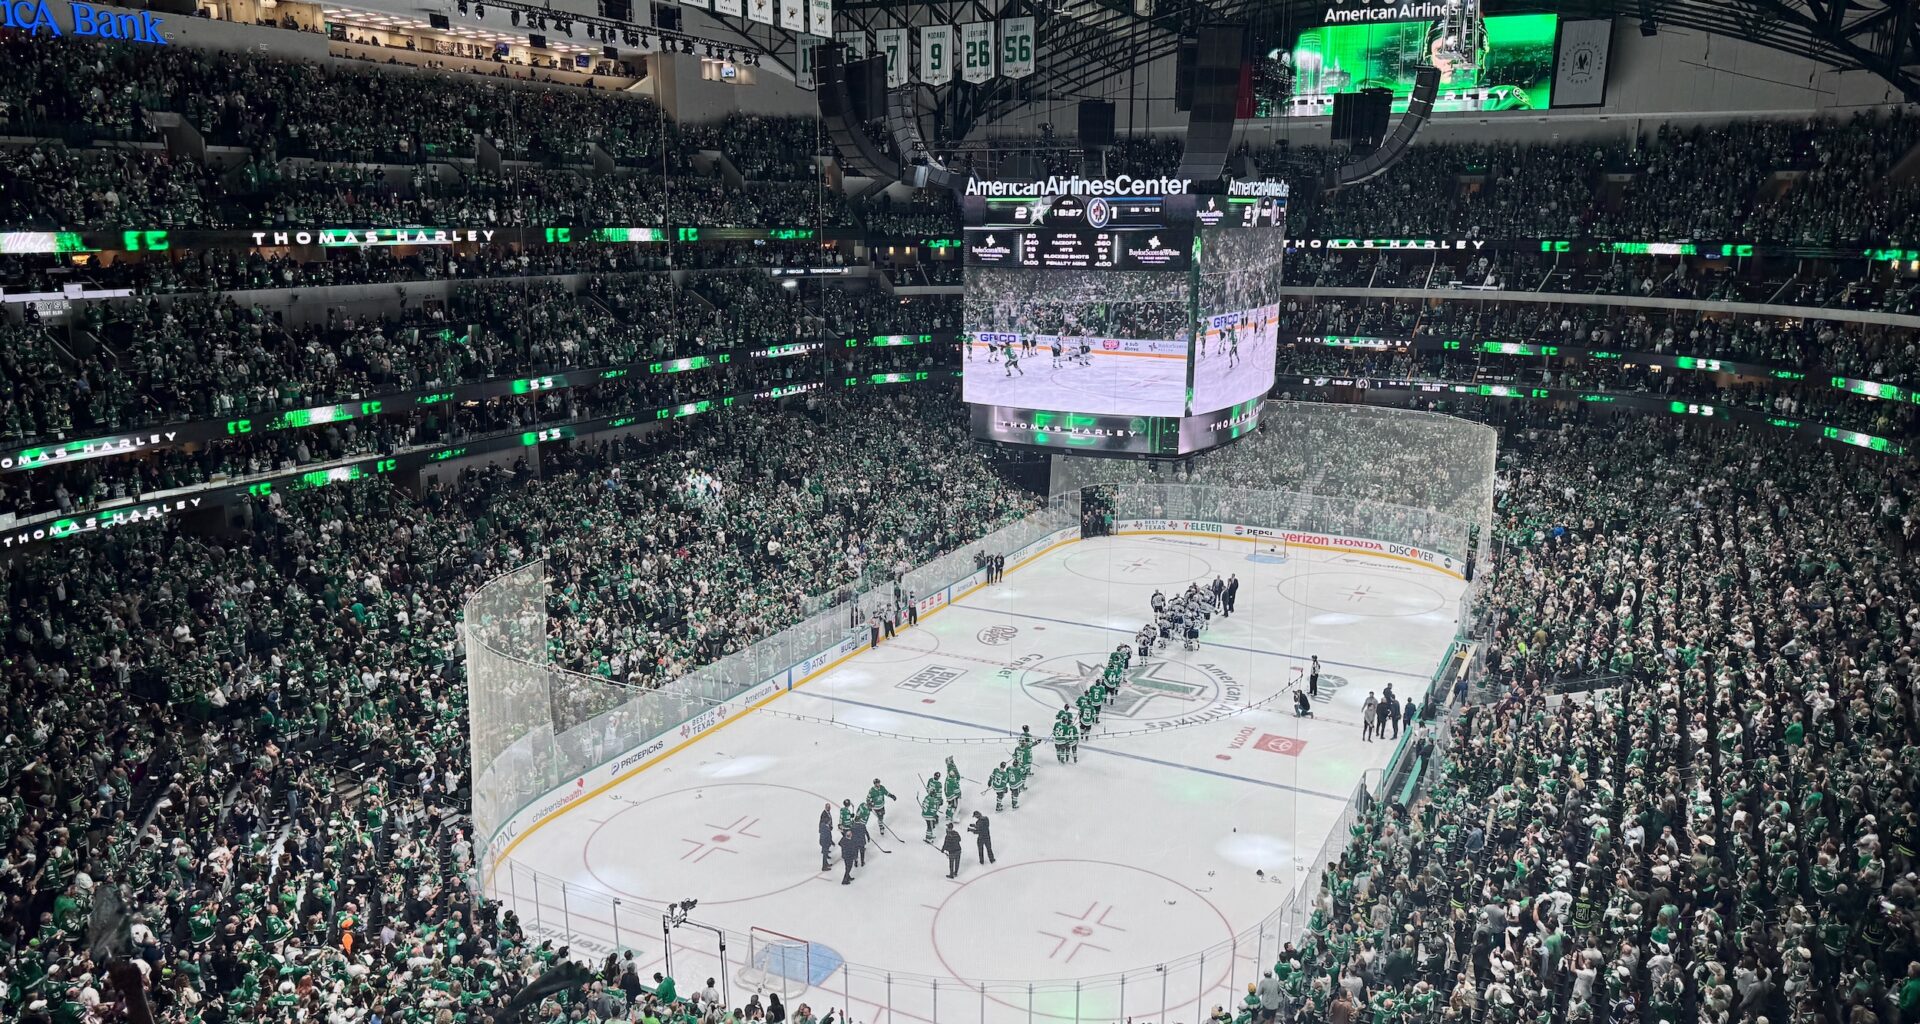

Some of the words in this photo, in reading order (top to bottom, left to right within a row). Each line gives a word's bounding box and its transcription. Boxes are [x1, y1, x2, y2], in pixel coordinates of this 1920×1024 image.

[69, 2, 168, 44] Bank
[1325, 8, 1397, 23] American
[931, 43, 942, 70] 9
[966, 40, 989, 67] 26
[1004, 35, 1030, 62] 56
[887, 45, 898, 71] 7
[1014, 206, 1028, 219] 2
[1110, 206, 1118, 219] 1
[1244, 205, 1252, 219] 2
[253, 231, 378, 246] THOMAS
[396, 229, 495, 244] HARLEY
[1283, 239, 1374, 249] THOMAS
[1389, 239, 1486, 250] HARLEY
[750, 347, 787, 358] THOMAS
[788, 343, 824, 354] HARLEY
[1296, 336, 1350, 345] THOMAS
[1359, 338, 1412, 347] HARLEY
[754, 387, 788, 400] THOMAS
[1002, 421, 1062, 432] THOMAS
[1071, 427, 1137, 437] HARLEY
[1209, 412, 1246, 432] THOMAS
[0, 448, 67, 469] OMAS
[83, 431, 177, 453] HARLEY
[4, 517, 97, 548] THOMAS
[112, 498, 202, 522] HARLEY
[1281, 532, 1329, 546] verizon
[1333, 538, 1383, 550] HONDA
[1389, 544, 1434, 562] DISCOVER
[812, 654, 827, 670] AT&T
[996, 653, 1044, 679] Center
[903, 666, 947, 689] LIGHT
[923, 671, 958, 688] BUD
[1197, 662, 1244, 702] American
[744, 685, 772, 705] American
[1094, 691, 1099, 700] 6
[691, 714, 707, 727] BEST
[692, 717, 715, 735] TEXAS
[1227, 726, 1256, 749] TOYOTA
[620, 741, 664, 769] PRIZEPICKS
[496, 820, 518, 852] PNC
[1561, 902, 1568, 914] 4
[1576, 907, 1590, 921] 21
[525, 922, 614, 955] nterprise
